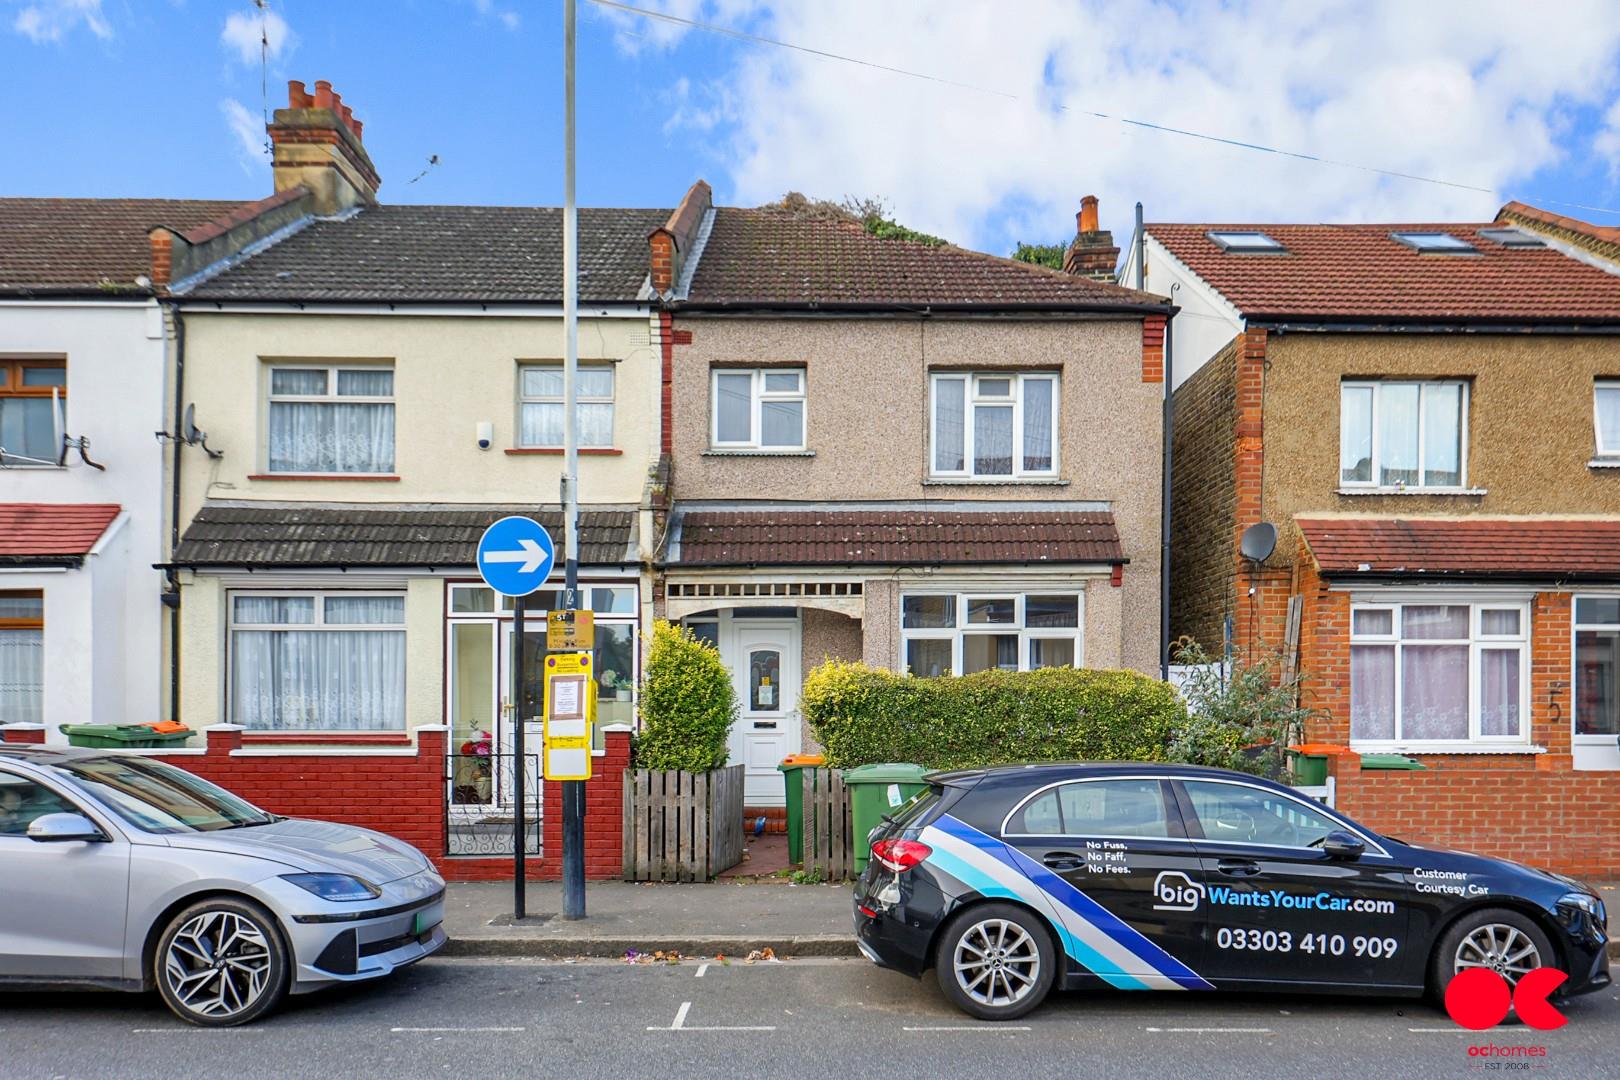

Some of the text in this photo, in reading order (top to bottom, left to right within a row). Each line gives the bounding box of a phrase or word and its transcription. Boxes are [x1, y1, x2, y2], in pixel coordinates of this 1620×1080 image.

[1549, 690, 1563, 723] 5
[1086, 841, 1128, 850] No Fuss,
[1087, 852, 1127, 862] No Faff,
[1088, 864, 1131, 873] No Fees.
[1413, 867, 1467, 880] Customer
[1415, 882, 1489, 896] Courtesy Car
[1160, 883, 1395, 914] big WantsYourCar.com
[1216, 927, 1398, 959] 03303 410 909
